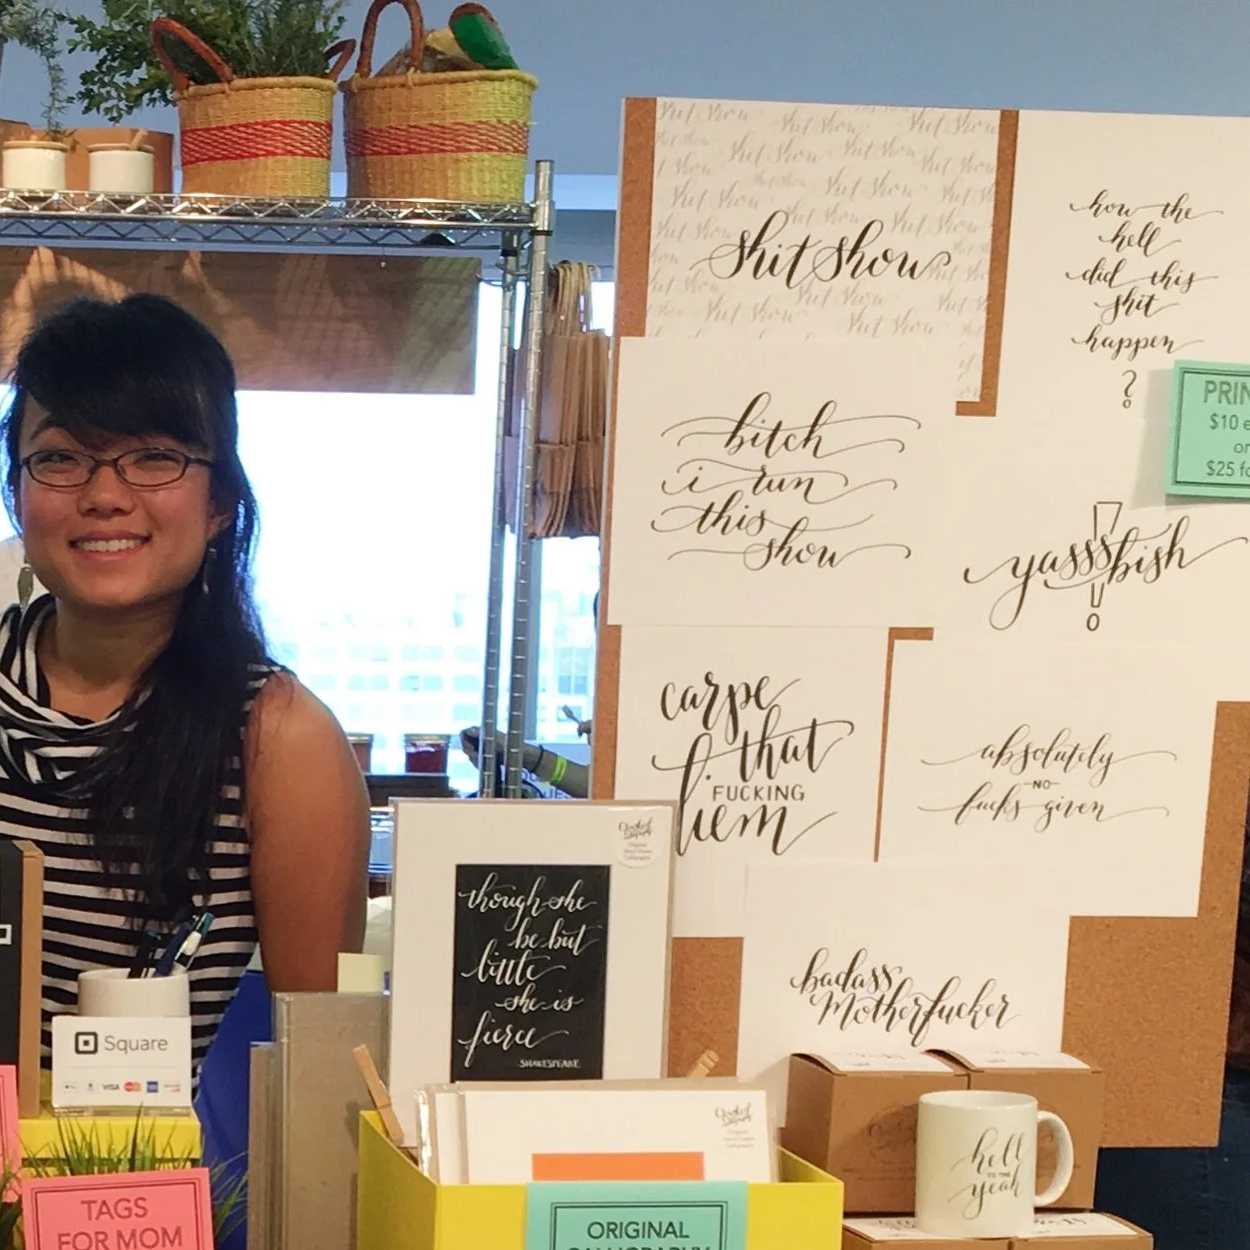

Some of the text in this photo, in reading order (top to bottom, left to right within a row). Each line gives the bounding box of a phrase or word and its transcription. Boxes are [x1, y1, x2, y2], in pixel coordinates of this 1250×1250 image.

[1070, 189, 1223, 224] how the
[696, 210, 951, 289] shit show
[1098, 220, 1181, 257] hell
[1066, 256, 1217, 294] did this
[1094, 286, 1178, 326] shit
[1071, 324, 1204, 361] happen
[1203, 379, 1250, 405] PRIN
[1210, 413, 1239, 431] $10
[1206, 460, 1235, 477] $25
[660, 671, 800, 745] carpe
[950, 723, 1140, 788] absolutely
[712, 784, 805, 802] FUCKING
[458, 872, 597, 932] though she
[508, 917, 602, 955] be but
[462, 939, 566, 986] little
[790, 948, 902, 993] badass
[495, 983, 584, 1014] she is
[810, 977, 1021, 1047] Motherfucker
[104, 1035, 168, 1055] Square
[458, 1010, 568, 1068] fierce
[956, 1127, 1025, 1174] hell
[81, 1197, 149, 1221] TAGS
[949, 1164, 1022, 1219] yeah
[116, 1226, 182, 1250] MOM
[586, 1221, 690, 1240] ORIGINAL
